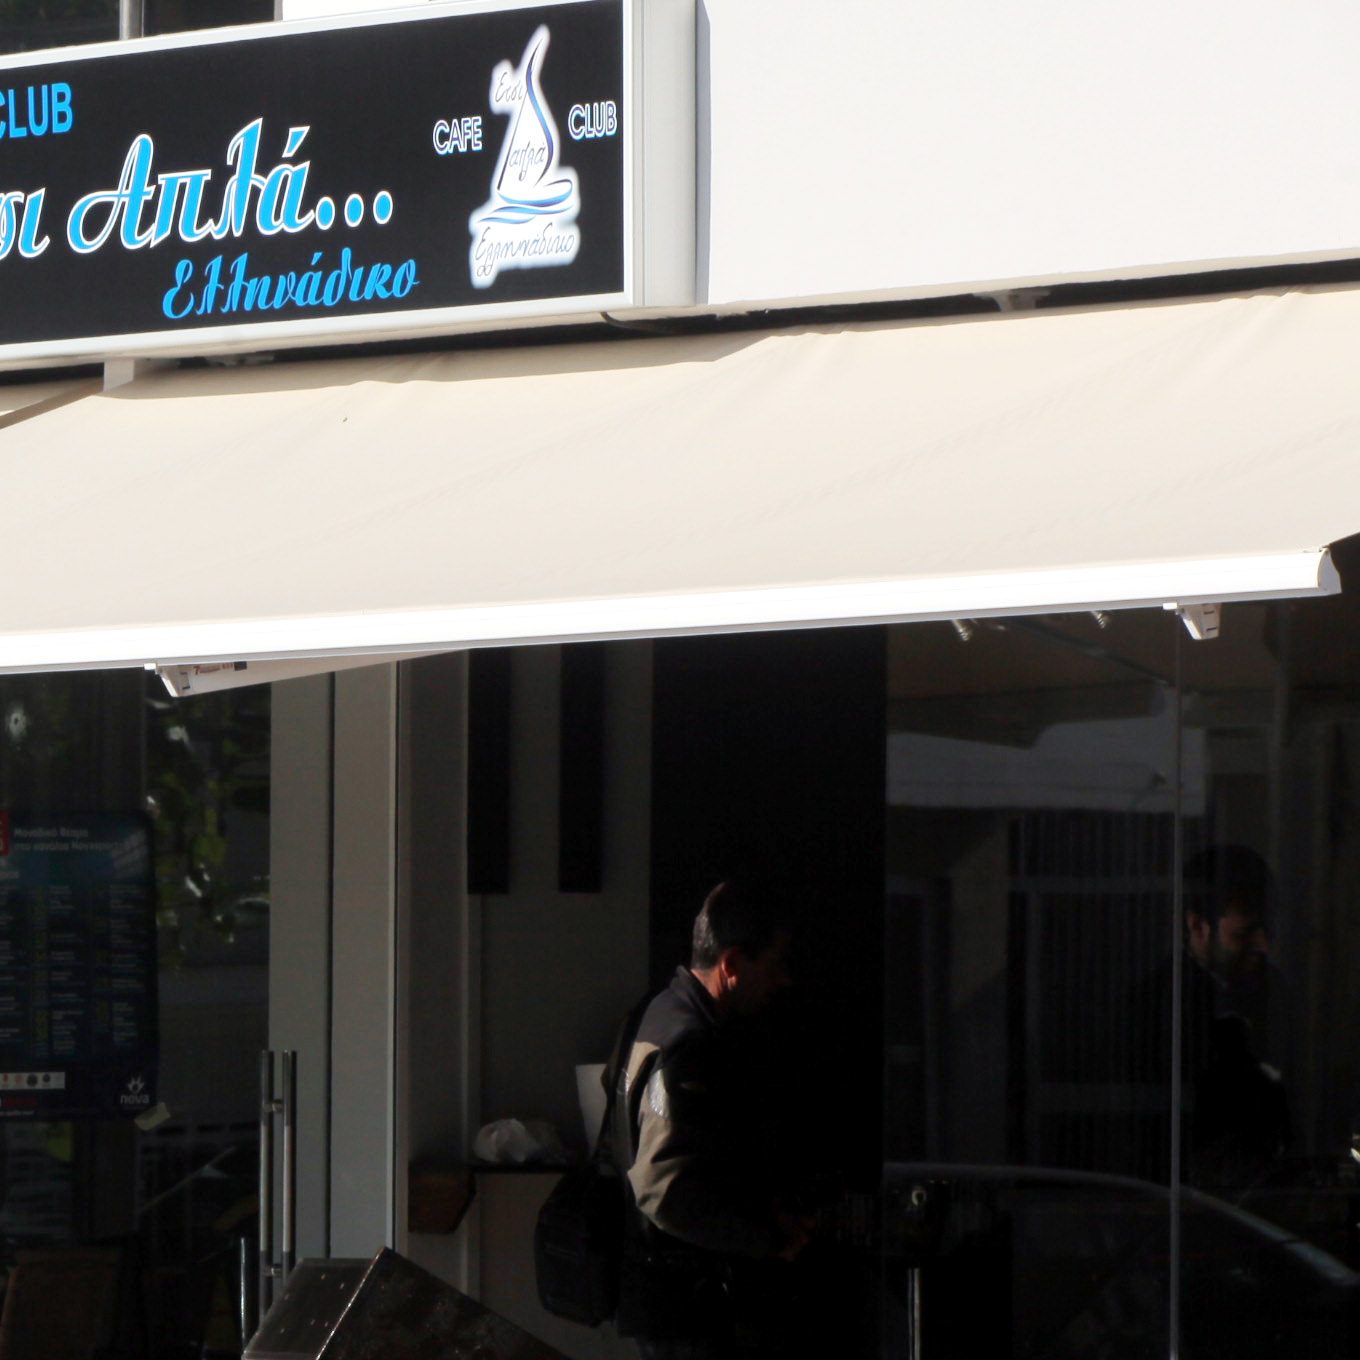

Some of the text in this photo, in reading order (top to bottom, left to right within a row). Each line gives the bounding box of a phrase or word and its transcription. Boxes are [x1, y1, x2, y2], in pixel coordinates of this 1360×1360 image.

[433, 100, 618, 155] CAFE CLUB
[162, 246, 420, 322] Ελληνάδικο
[120, 1093, 151, 1104] nova
